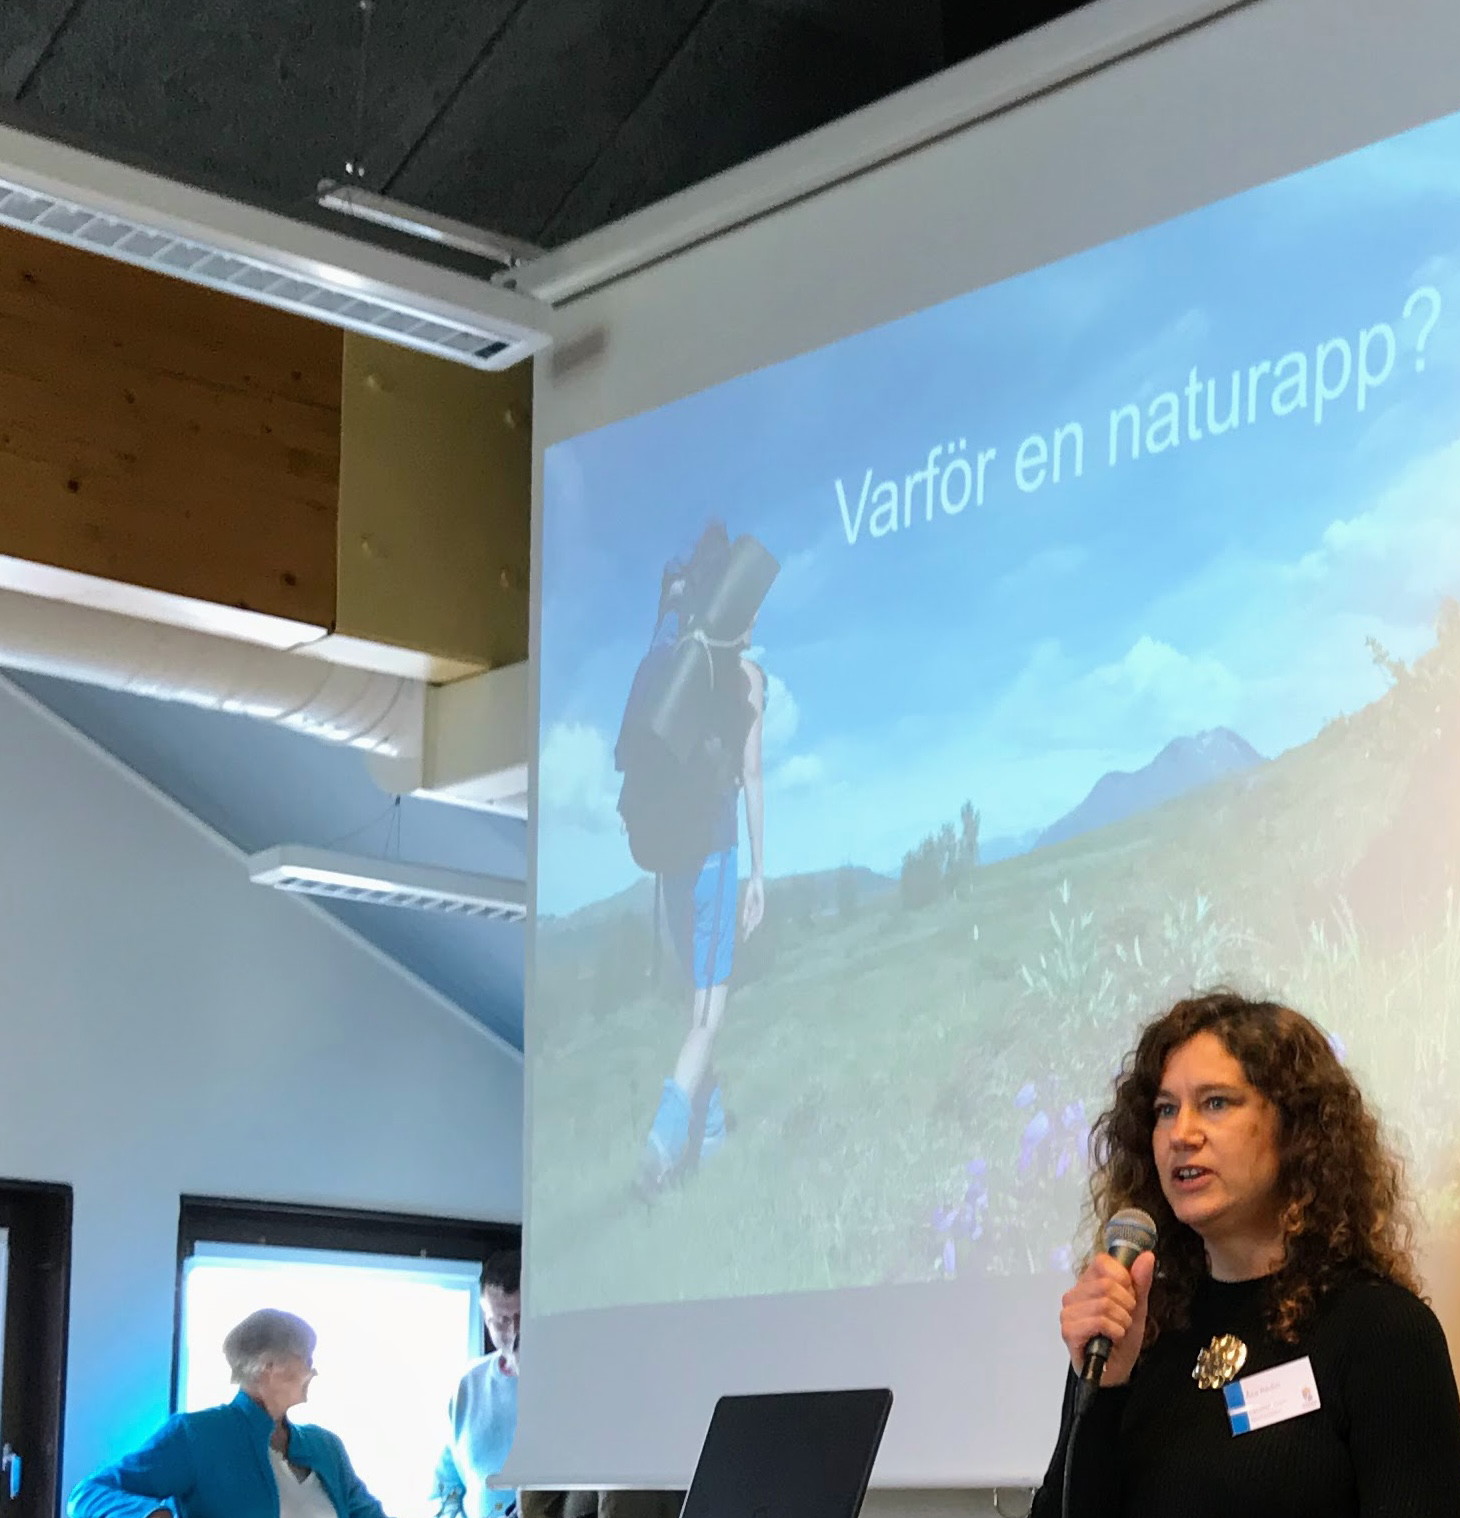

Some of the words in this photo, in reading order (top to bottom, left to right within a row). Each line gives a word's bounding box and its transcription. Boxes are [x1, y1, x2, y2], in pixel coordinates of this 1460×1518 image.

[835, 437, 997, 546] Varför
[1013, 421, 1084, 493] en
[1108, 285, 1443, 467] naturapp?
